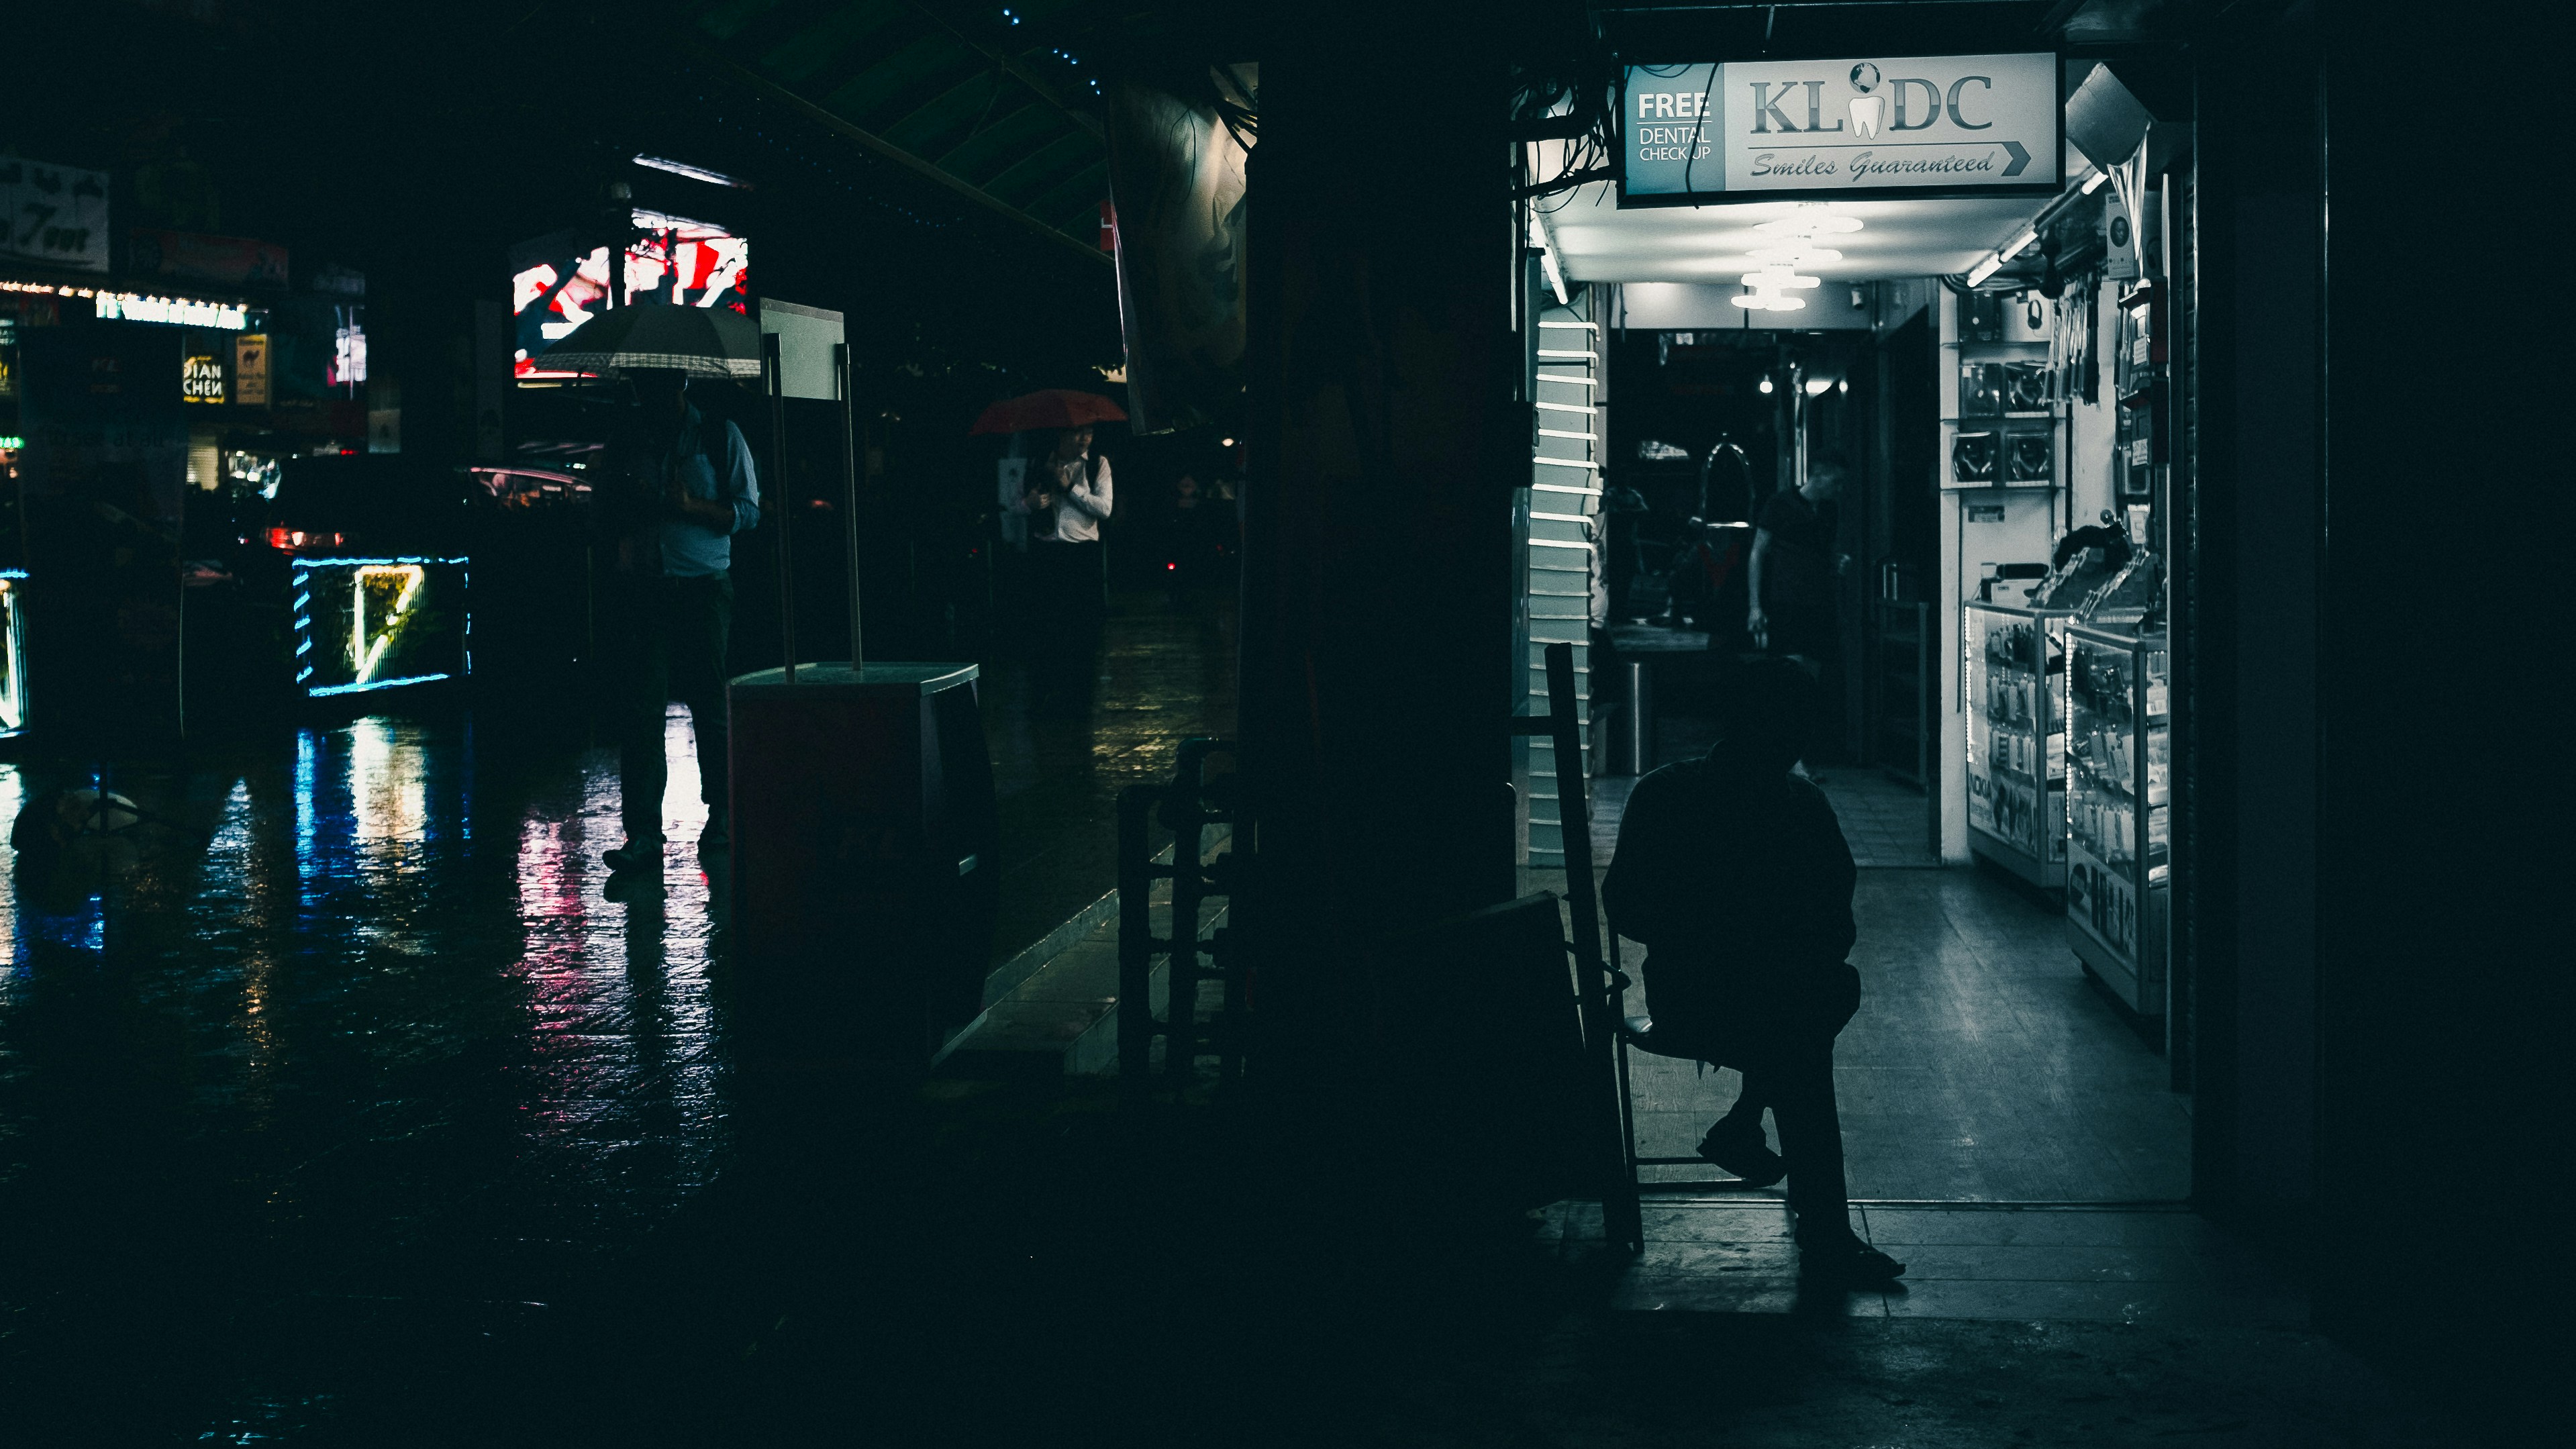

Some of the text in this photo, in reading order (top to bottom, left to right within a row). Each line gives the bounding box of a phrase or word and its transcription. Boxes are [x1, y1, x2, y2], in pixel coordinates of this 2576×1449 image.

[1638, 92, 1711, 118] FREE
[1639, 127, 1712, 145] DENTAL
[1639, 147, 1687, 161] CHECK
[1749, 150, 1995, 183] Smiles Guaranteed
